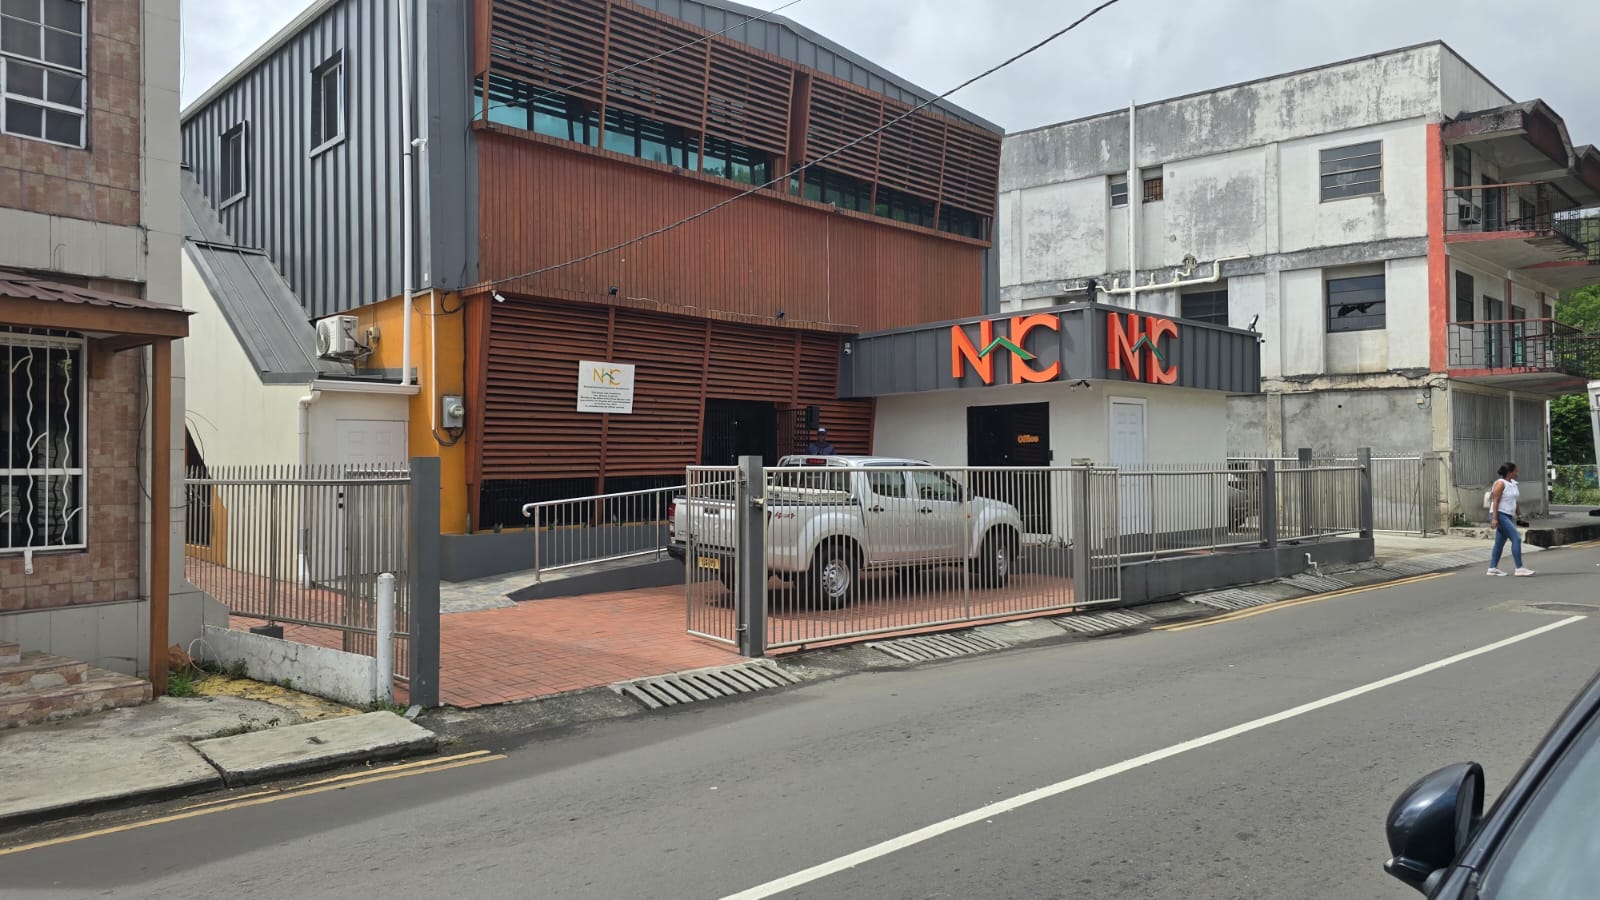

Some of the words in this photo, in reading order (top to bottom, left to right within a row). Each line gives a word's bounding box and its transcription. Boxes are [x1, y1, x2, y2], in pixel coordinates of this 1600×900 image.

[593, 368, 622, 385] NHC
[951, 313, 1060, 384] NHC
[1108, 312, 1178, 384] NHC
